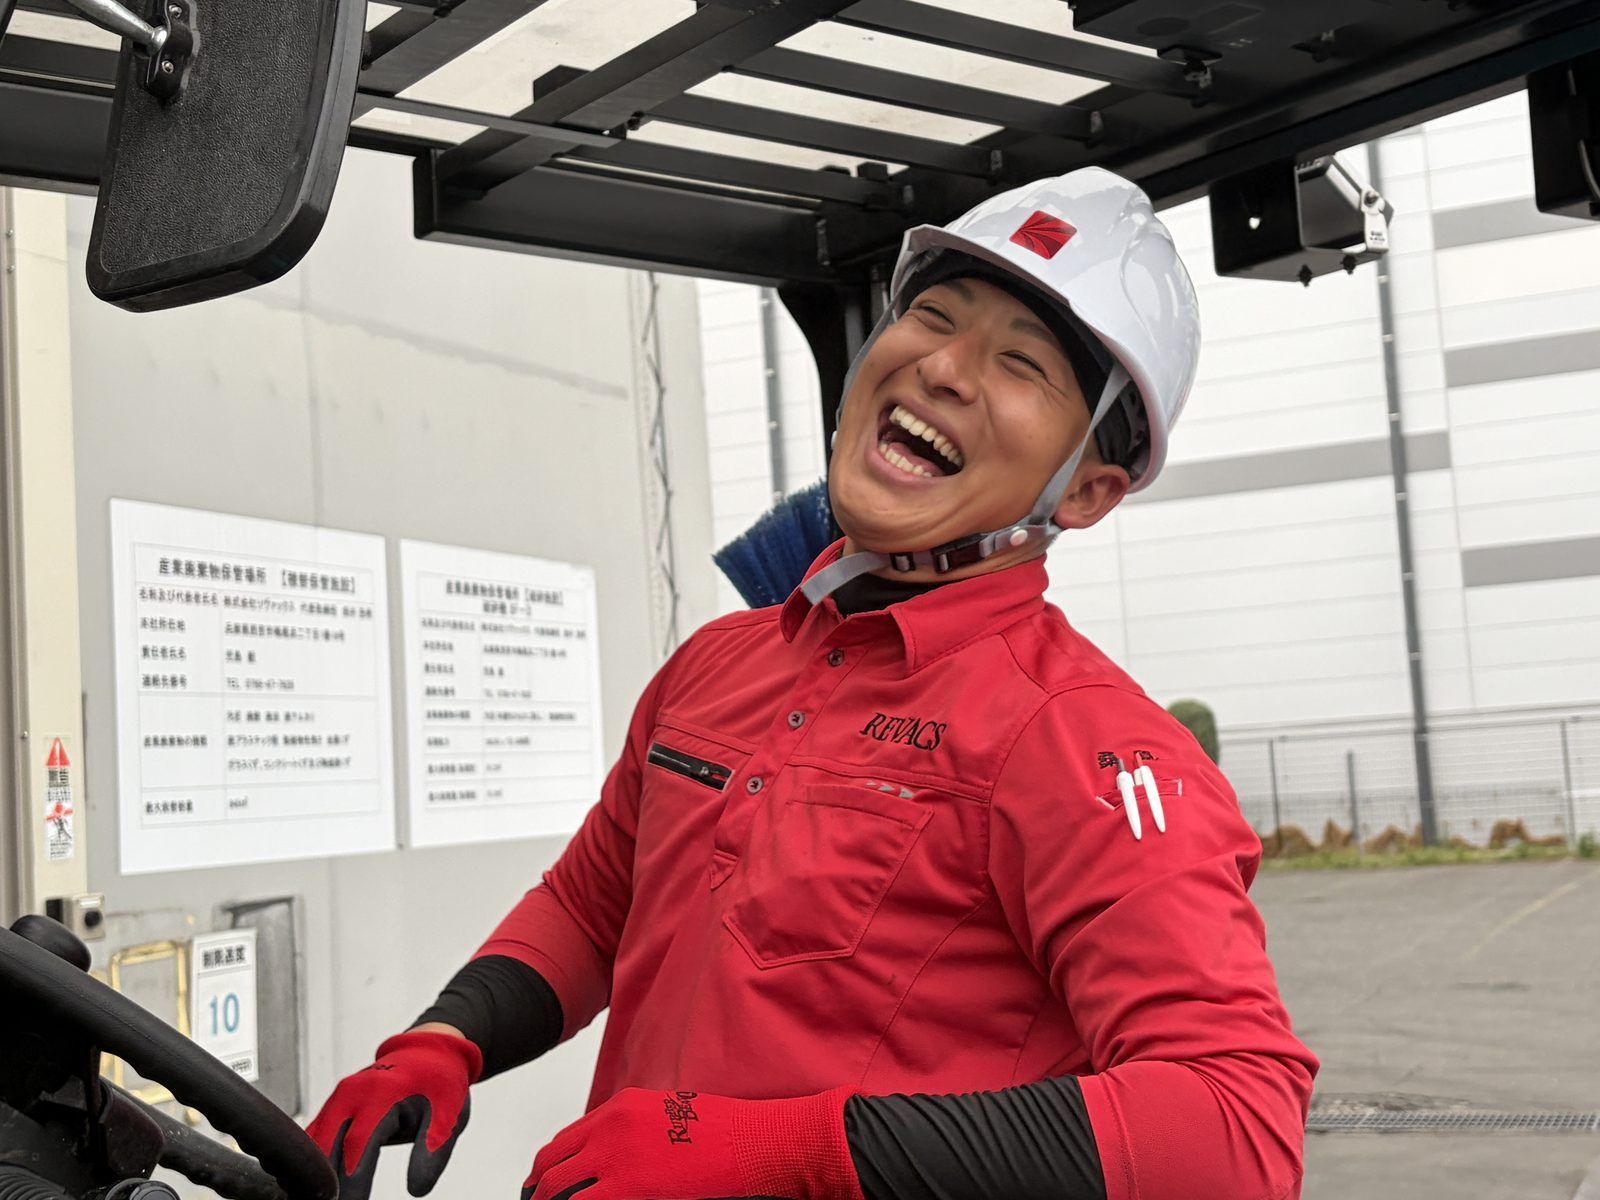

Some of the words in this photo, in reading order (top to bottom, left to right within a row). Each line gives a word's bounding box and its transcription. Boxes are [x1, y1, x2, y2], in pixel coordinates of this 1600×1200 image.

[159, 558, 267, 584] 産業廃棄物保管場所
[860, 713, 947, 751] REVACS
[202, 945, 246, 967] 制限速度
[209, 992, 240, 1036] 10
